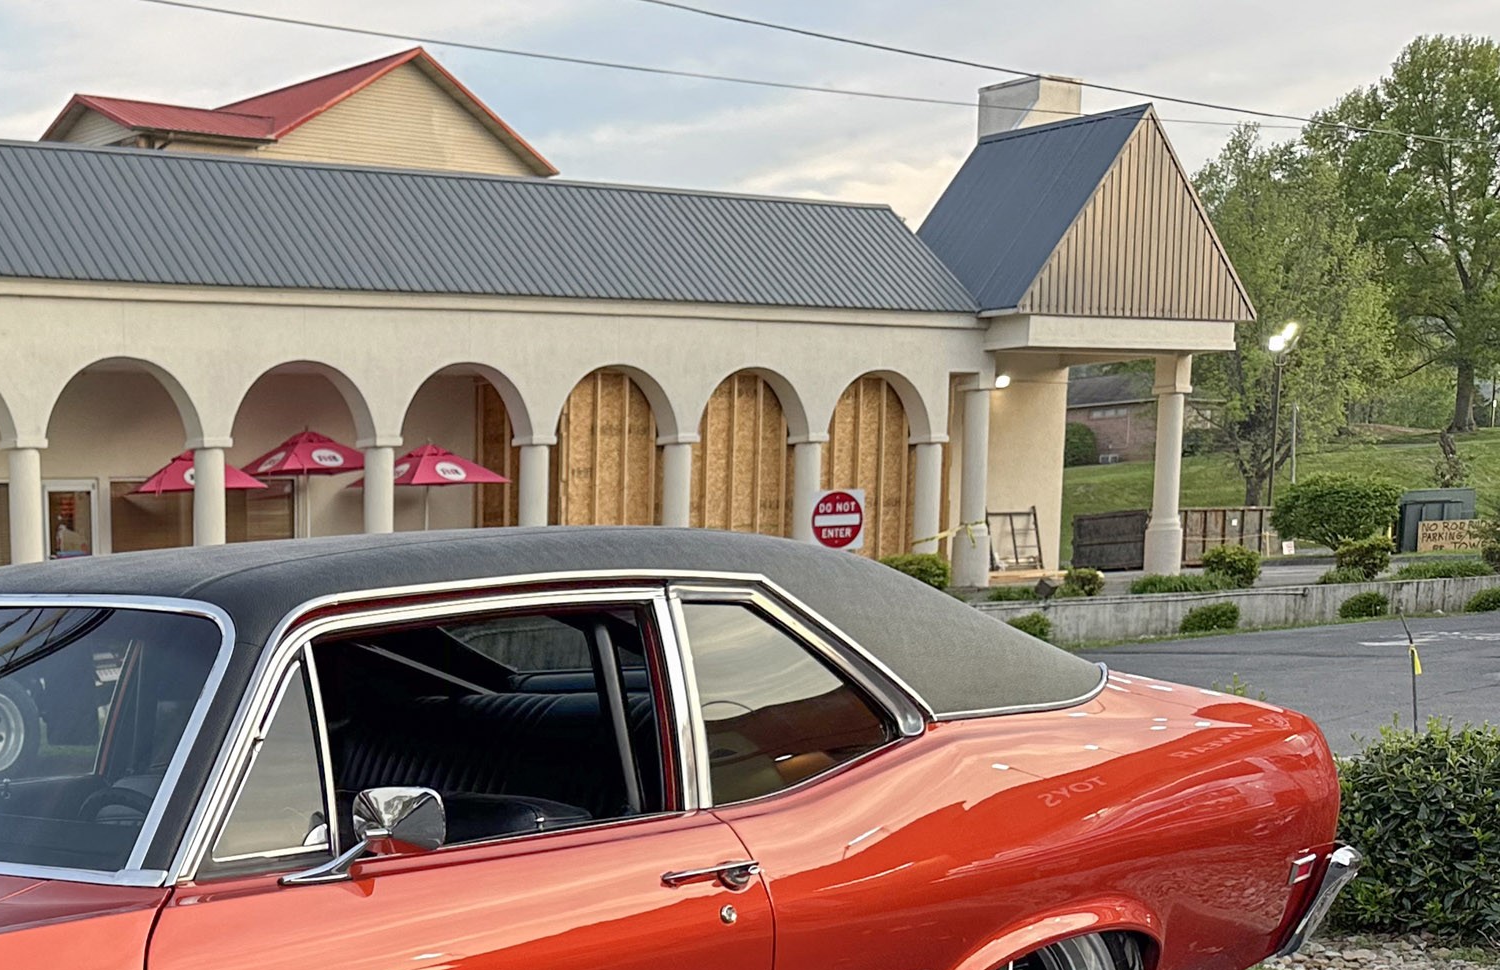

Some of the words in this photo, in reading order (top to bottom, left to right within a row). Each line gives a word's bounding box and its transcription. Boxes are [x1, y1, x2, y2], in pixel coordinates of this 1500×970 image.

[819, 502, 832, 514] DO
[836, 501, 856, 512] NOT
[821, 527, 852, 540] ENTER
[1421, 522, 1438, 533] NO
[1422, 532, 1463, 542] PARKING
